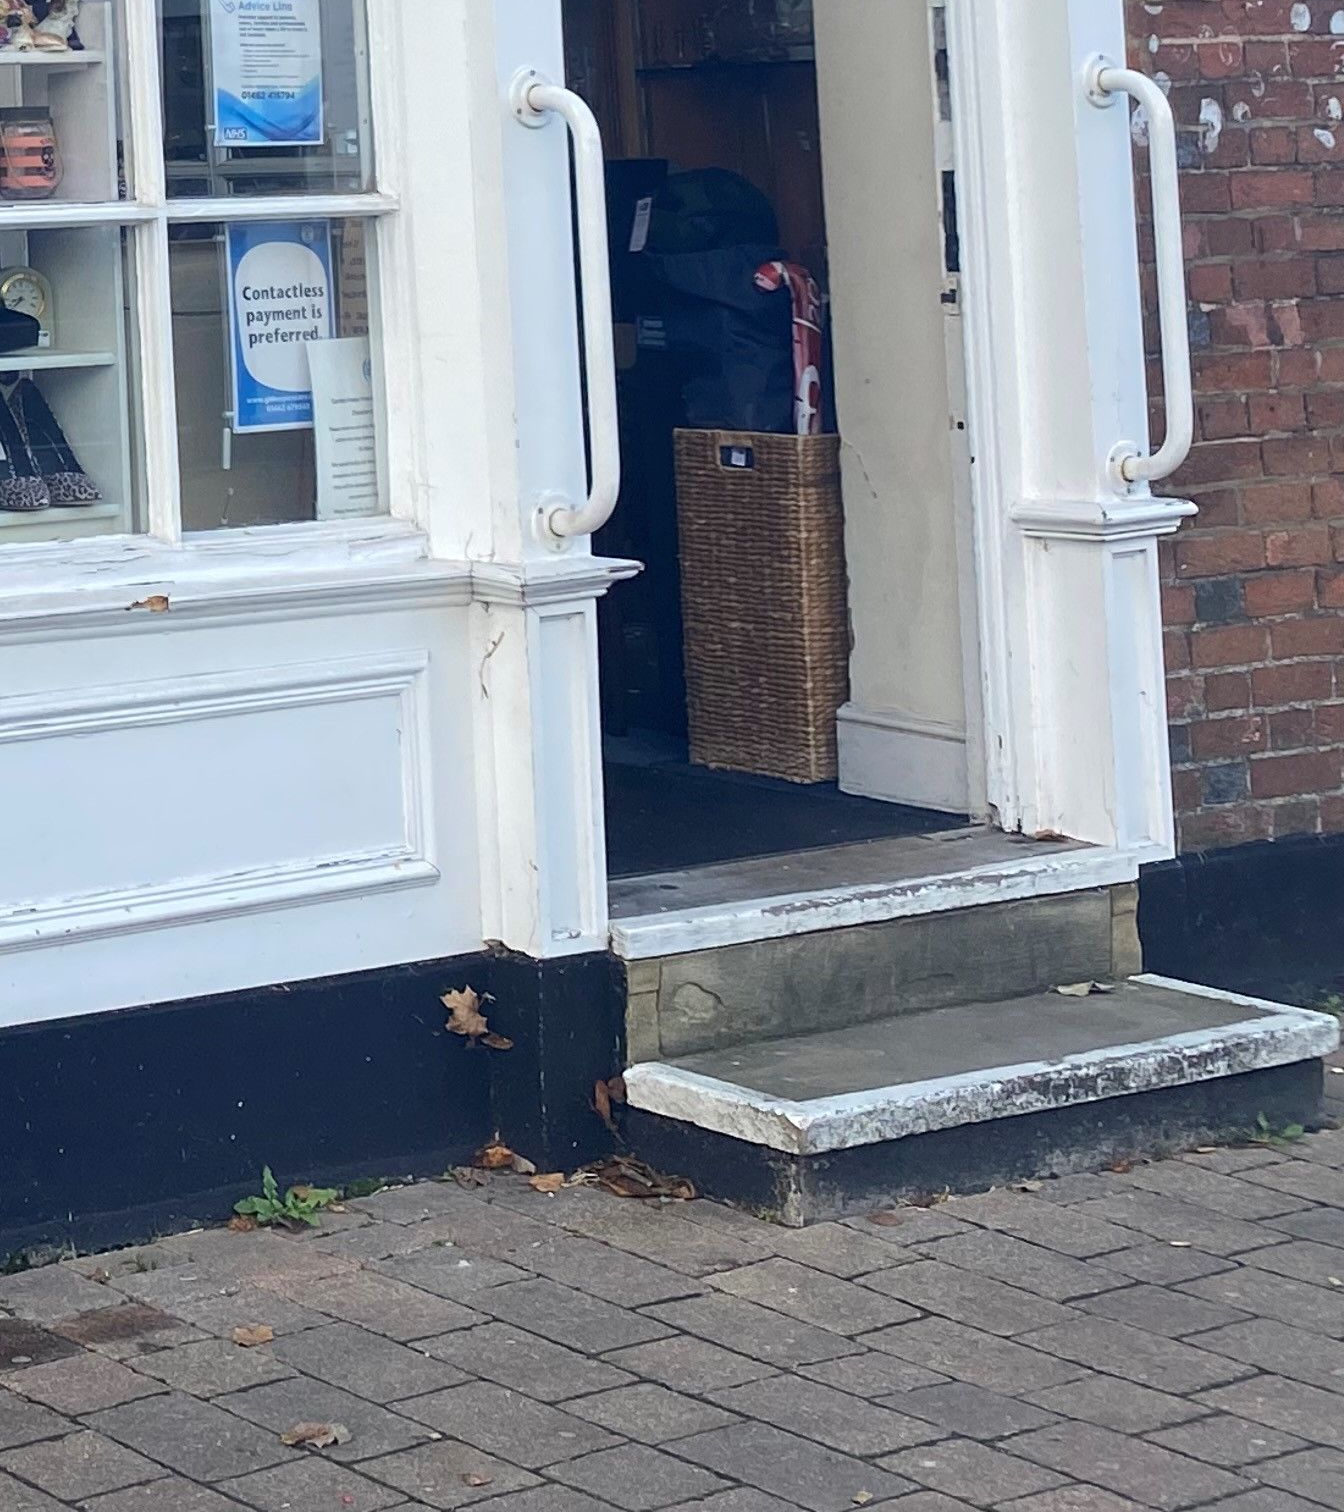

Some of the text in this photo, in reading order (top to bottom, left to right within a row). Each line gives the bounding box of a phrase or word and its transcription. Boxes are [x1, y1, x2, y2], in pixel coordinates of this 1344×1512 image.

[238, 0, 293, 12] Advice Line
[224, 128, 246, 139] NHS
[242, 283, 324, 301] Contactless
[246, 303, 322, 326] payment is
